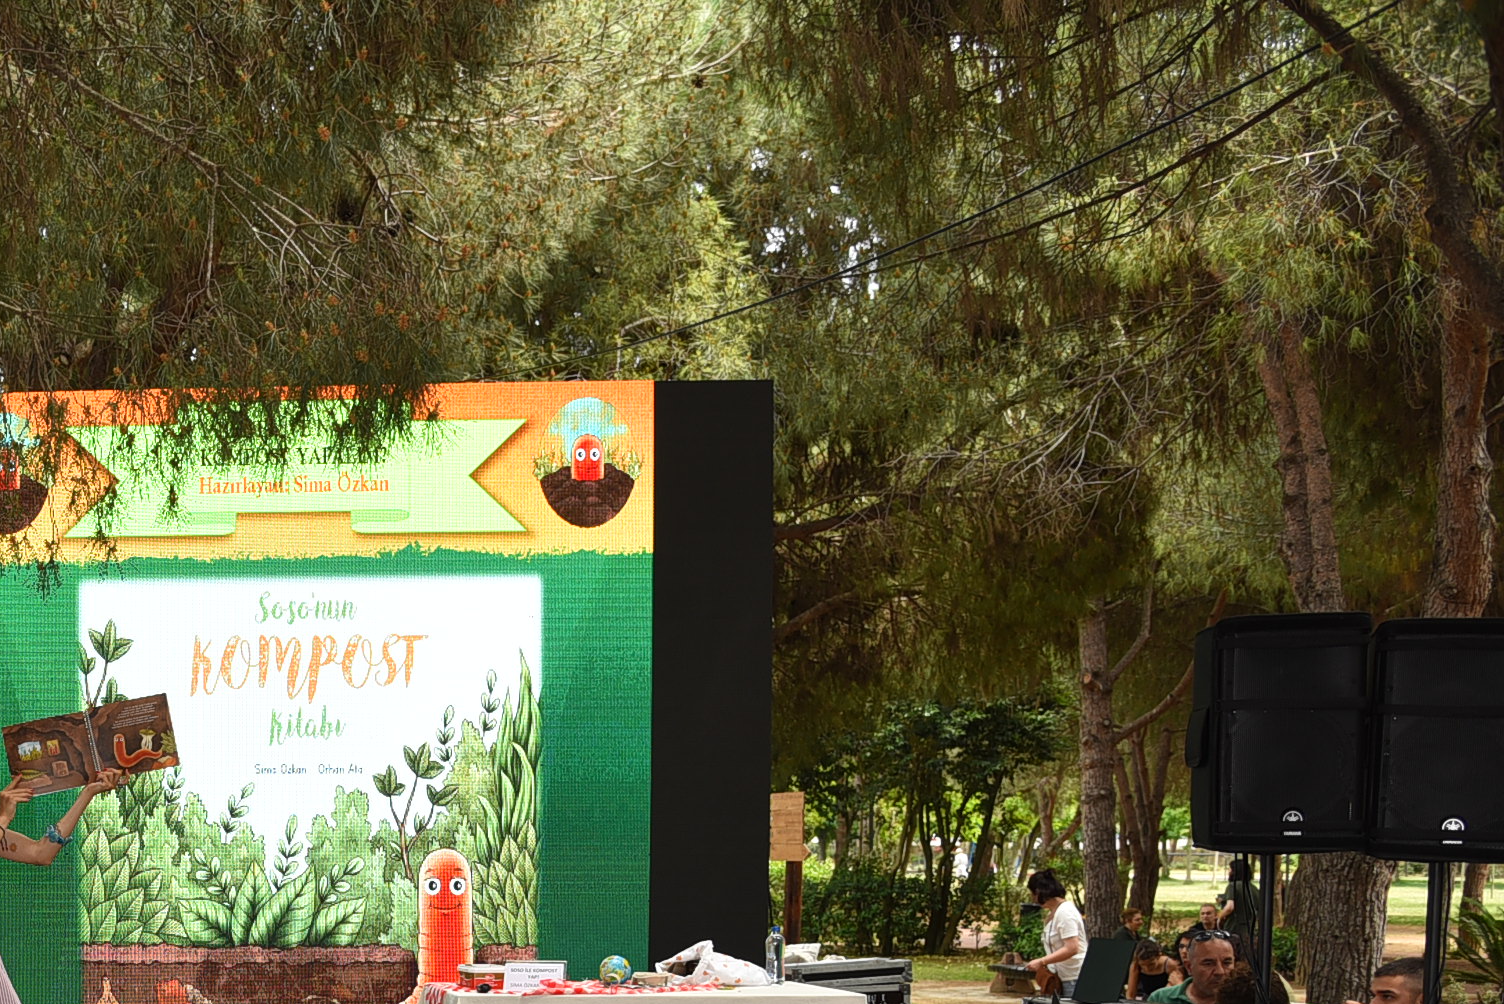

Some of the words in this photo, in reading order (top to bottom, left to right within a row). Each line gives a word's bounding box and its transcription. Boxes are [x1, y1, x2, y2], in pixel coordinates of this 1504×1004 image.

[294, 473, 332, 493] Sima
[337, 471, 390, 492] Özkan
[190, 633, 429, 704] KOMPOST
